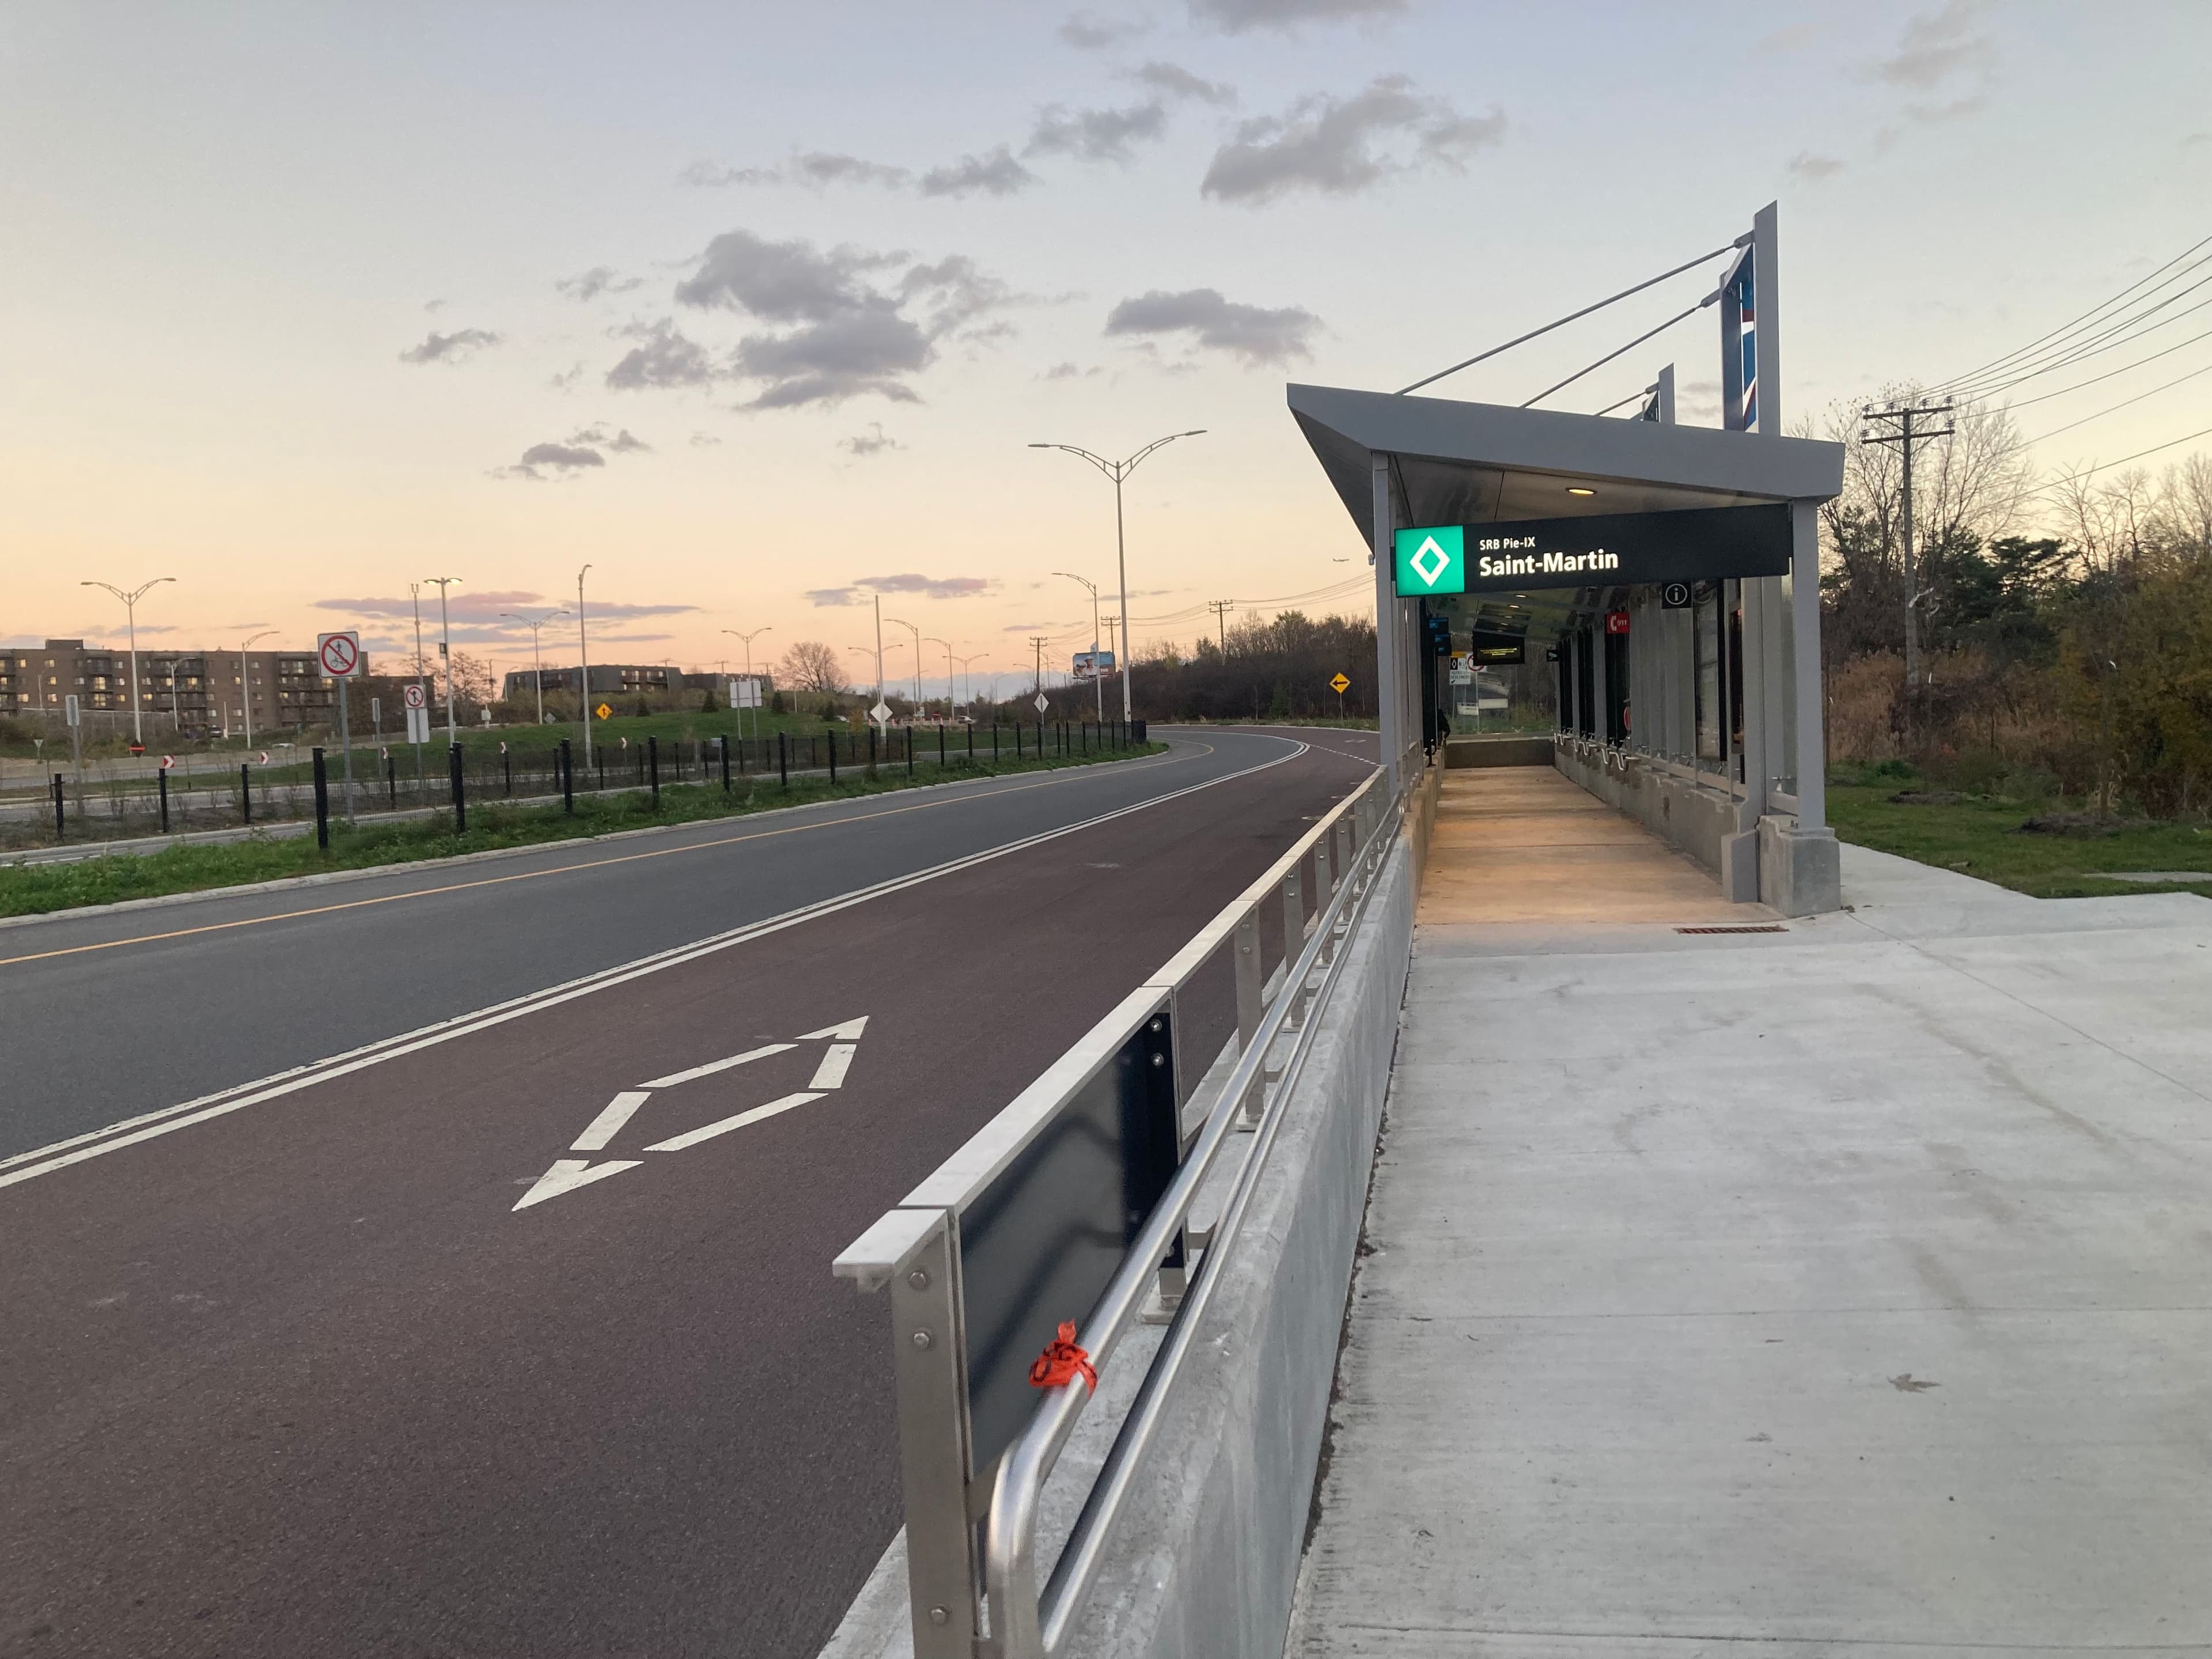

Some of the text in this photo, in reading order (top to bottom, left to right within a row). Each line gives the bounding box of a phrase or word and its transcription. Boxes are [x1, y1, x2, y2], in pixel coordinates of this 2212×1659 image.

[1479, 536, 1536, 551] SRB Pie-IX
[1479, 548, 1618, 576] Saint-Martin
